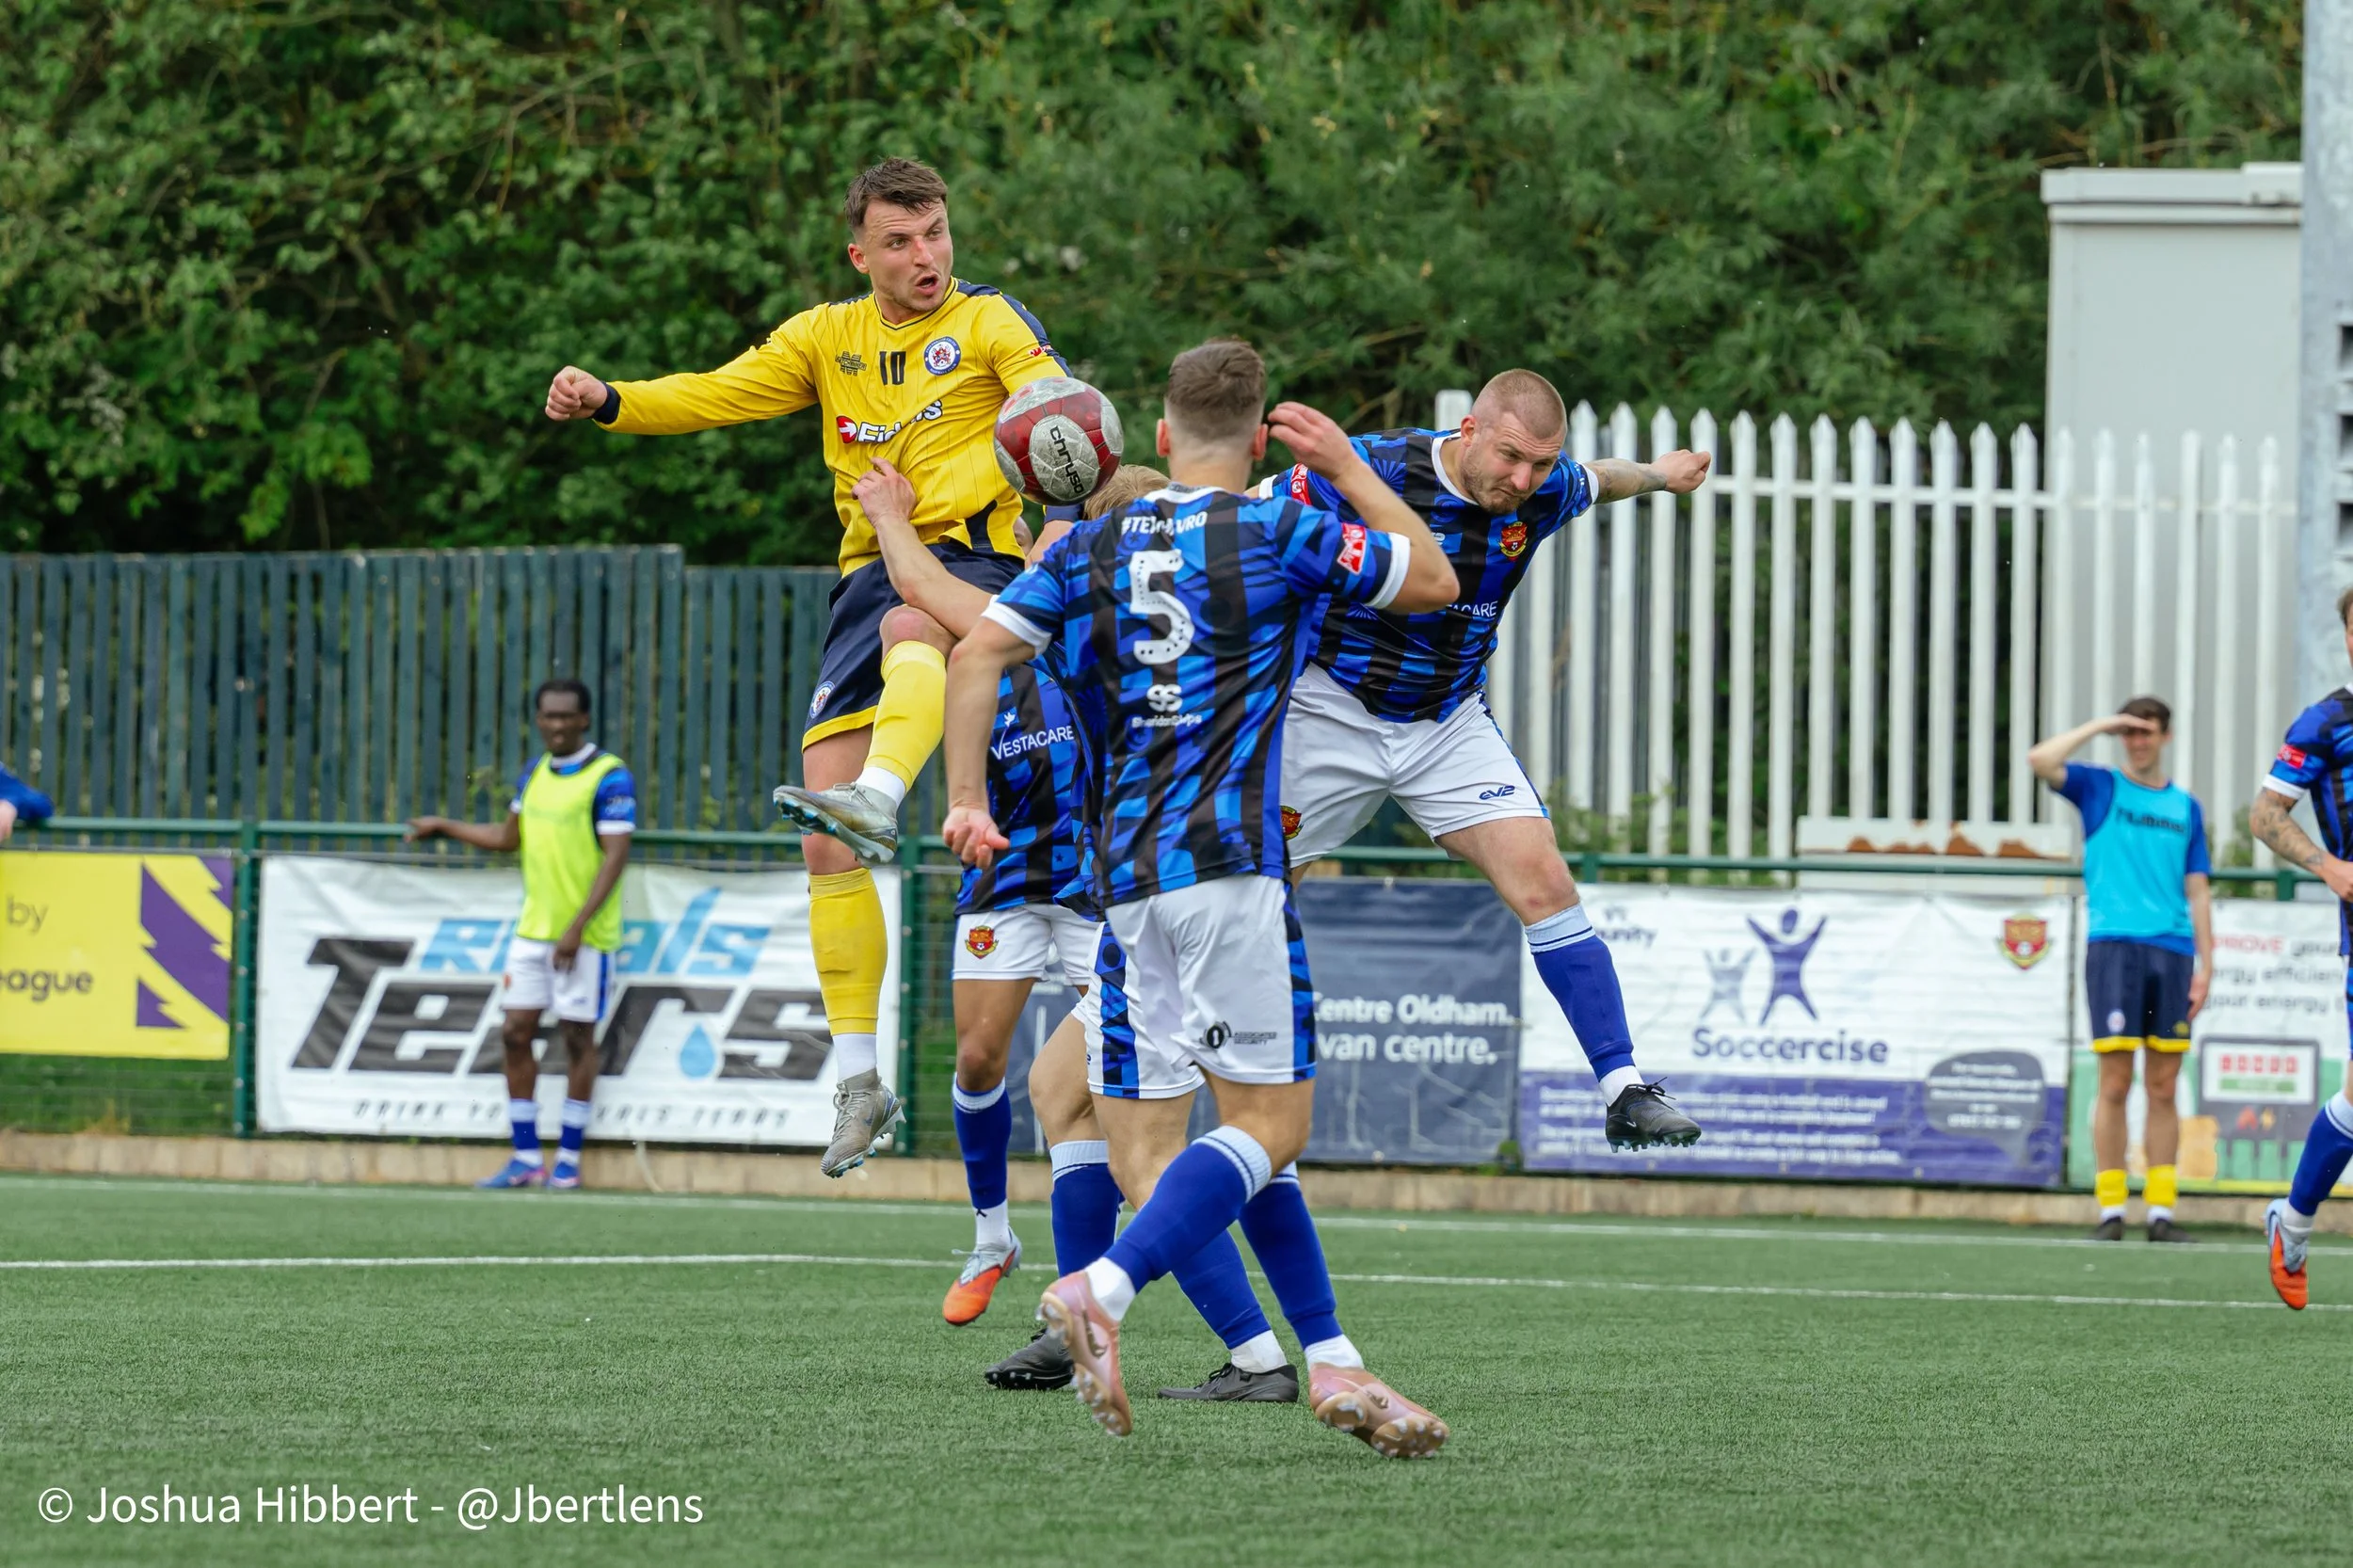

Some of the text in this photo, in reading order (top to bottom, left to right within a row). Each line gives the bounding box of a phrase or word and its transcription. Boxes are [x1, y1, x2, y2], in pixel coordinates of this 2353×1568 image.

[879, 350, 907, 387] 10
[1049, 425, 1084, 494] chryso
[1128, 549, 1195, 665] 5
[990, 725, 1075, 760] VESTACARE
[7, 894, 49, 936] by
[0, 968, 93, 1003] ague
[1397, 994, 1515, 1026] Oldham.
[1318, 1032, 1497, 1065] van centre.
[1692, 1027, 1888, 1064] Soccercise
